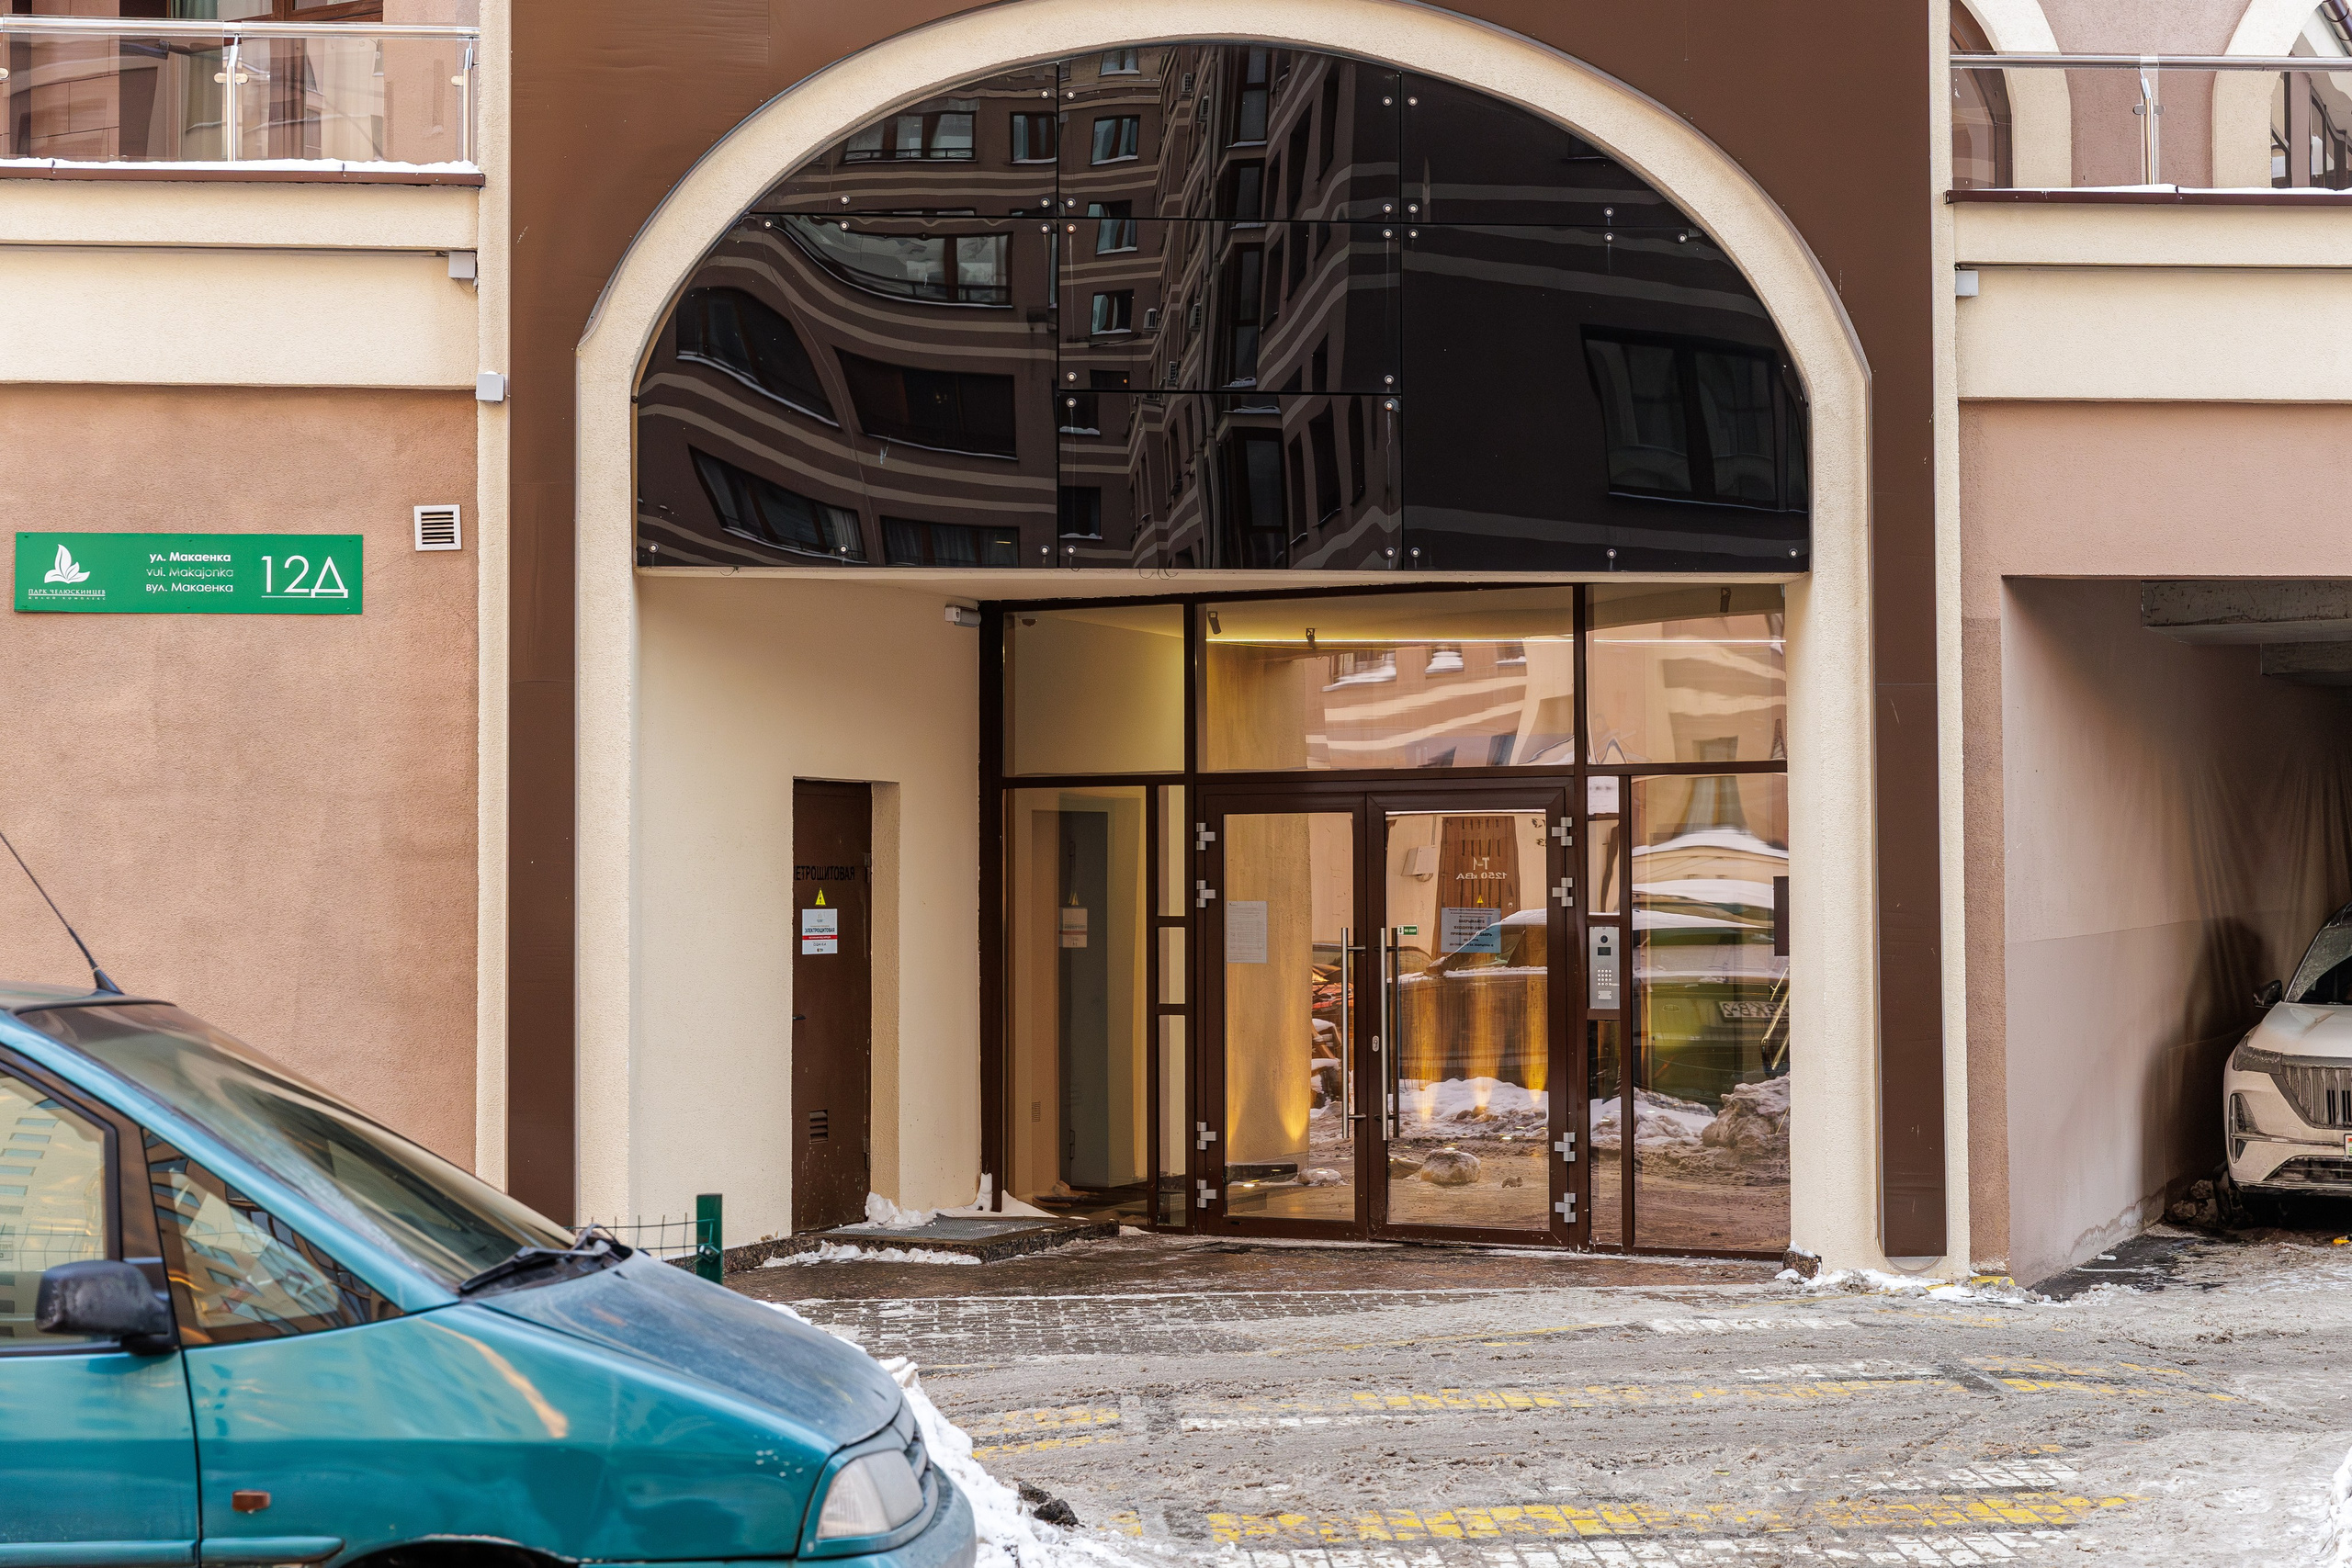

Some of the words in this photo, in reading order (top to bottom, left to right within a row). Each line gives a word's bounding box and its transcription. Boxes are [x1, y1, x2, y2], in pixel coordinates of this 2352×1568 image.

[149, 553, 166, 564] ул.
[169, 551, 232, 562] Макаенка
[169, 566, 234, 580] Makajonka
[261, 555, 348, 598] 12Д
[145, 583, 168, 594] вул.
[171, 581, 233, 592] Макаенка
